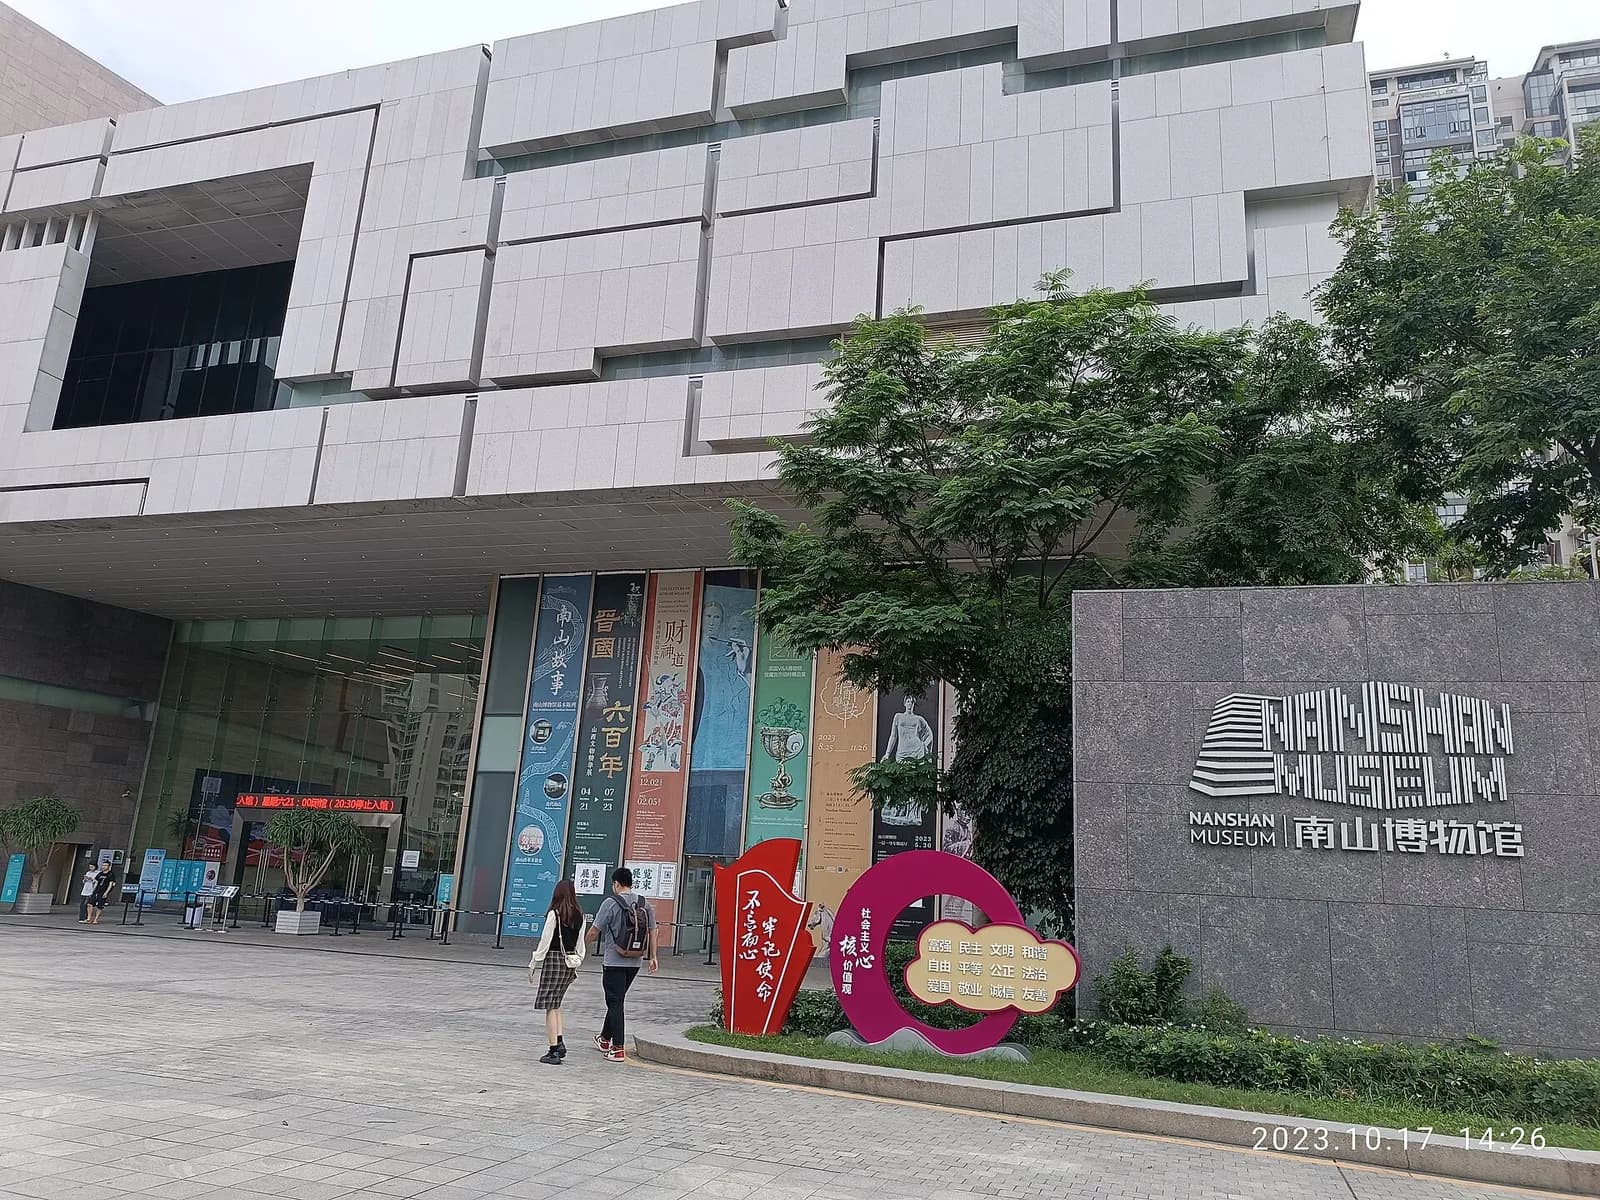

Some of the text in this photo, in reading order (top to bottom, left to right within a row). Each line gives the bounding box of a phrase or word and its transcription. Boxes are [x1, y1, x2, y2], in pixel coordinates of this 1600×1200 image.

[550, 605, 573, 696] 南山故事
[1262, 681, 1514, 754] NANSHAN
[599, 700, 631, 779] 六百年
[581, 788, 615, 796] 04 07
[1273, 754, 1508, 809] MUSEUM
[580, 802, 613, 811] 21 23
[1189, 811, 1275, 828] NANSHAN
[1190, 829, 1276, 847] MUSEUM
[1293, 815, 1525, 857] 南山博物馆
[739, 890, 761, 960] 不忘初心
[860, 907, 872, 953] 社会主义
[756, 916, 781, 1003] 牢记使命
[839, 934, 875, 969] 核心
[928, 938, 1048, 960] 富强 民主 文明 和谐
[842, 960, 853, 995] 价值观
[928, 960, 1048, 980] 自由 平等 公正 法治
[927, 979, 1048, 1001] 爱国 敬业 诚信 友善
